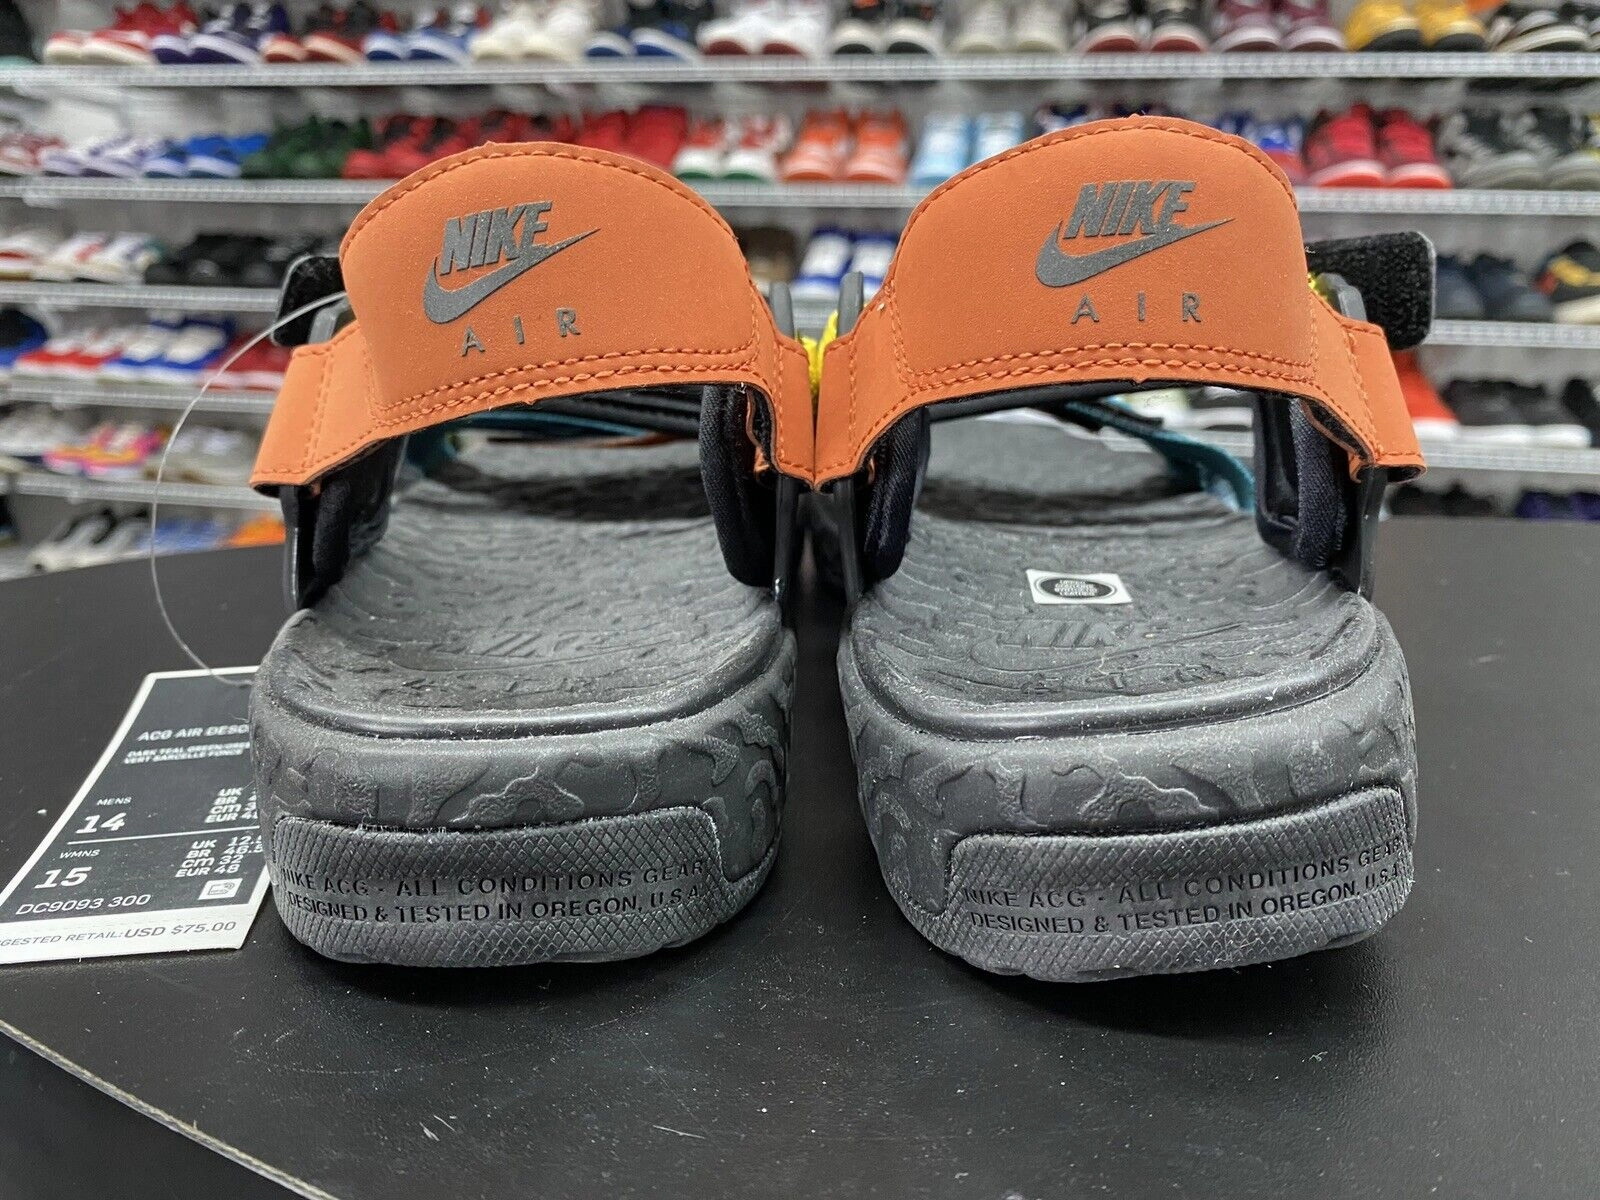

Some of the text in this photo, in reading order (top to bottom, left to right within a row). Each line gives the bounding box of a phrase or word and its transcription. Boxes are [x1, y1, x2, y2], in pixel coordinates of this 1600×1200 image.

[1063, 179, 1197, 239] NIKE
[439, 200, 553, 275] NIKE
[1070, 291, 1201, 325] AIR
[461, 307, 582, 357] AIR
[174, 727, 203, 739] AIR
[97, 797, 132, 806] MENS
[213, 796, 238, 805] BR
[217, 787, 243, 796] UK
[75, 812, 127, 834] 14
[204, 813, 239, 823] EUR
[60, 849, 100, 859] WMNS
[186, 849, 211, 859] BR
[191, 839, 217, 849] UK
[175, 863, 240, 877] EUR 48
[219, 854, 243, 865] 32
[34, 866, 92, 889] 15
[282, 867, 316, 891] NIKE
[324, 878, 369, 896] ACG
[396, 878, 440, 897] ALL
[458, 871, 632, 896] CONDITIONS
[643, 861, 703, 883] GEAR
[964, 888, 1021, 908] NIKE
[1029, 890, 1086, 909] ACG
[1118, 882, 1172, 904] ALL
[1184, 855, 1350, 897] CONDITIONS
[1358, 836, 1400, 867] GEAR
[15, 894, 152, 915] DC9093 300
[288, 891, 368, 922] DESIGNED
[375, 905, 389, 923] &
[396, 904, 490, 923] TESTED
[499, 902, 522, 920] IN
[532, 895, 643, 917] OREGON,
[970, 911, 1084, 934] DESIGNED
[1094, 915, 1112, 933] &
[1118, 904, 1220, 931] TESTED
[1229, 900, 1252, 919] IN
[1261, 882, 1360, 915] OREGON,
[0, 935, 61, 947] GESTED
[171, 921, 237, 936] $75.00
